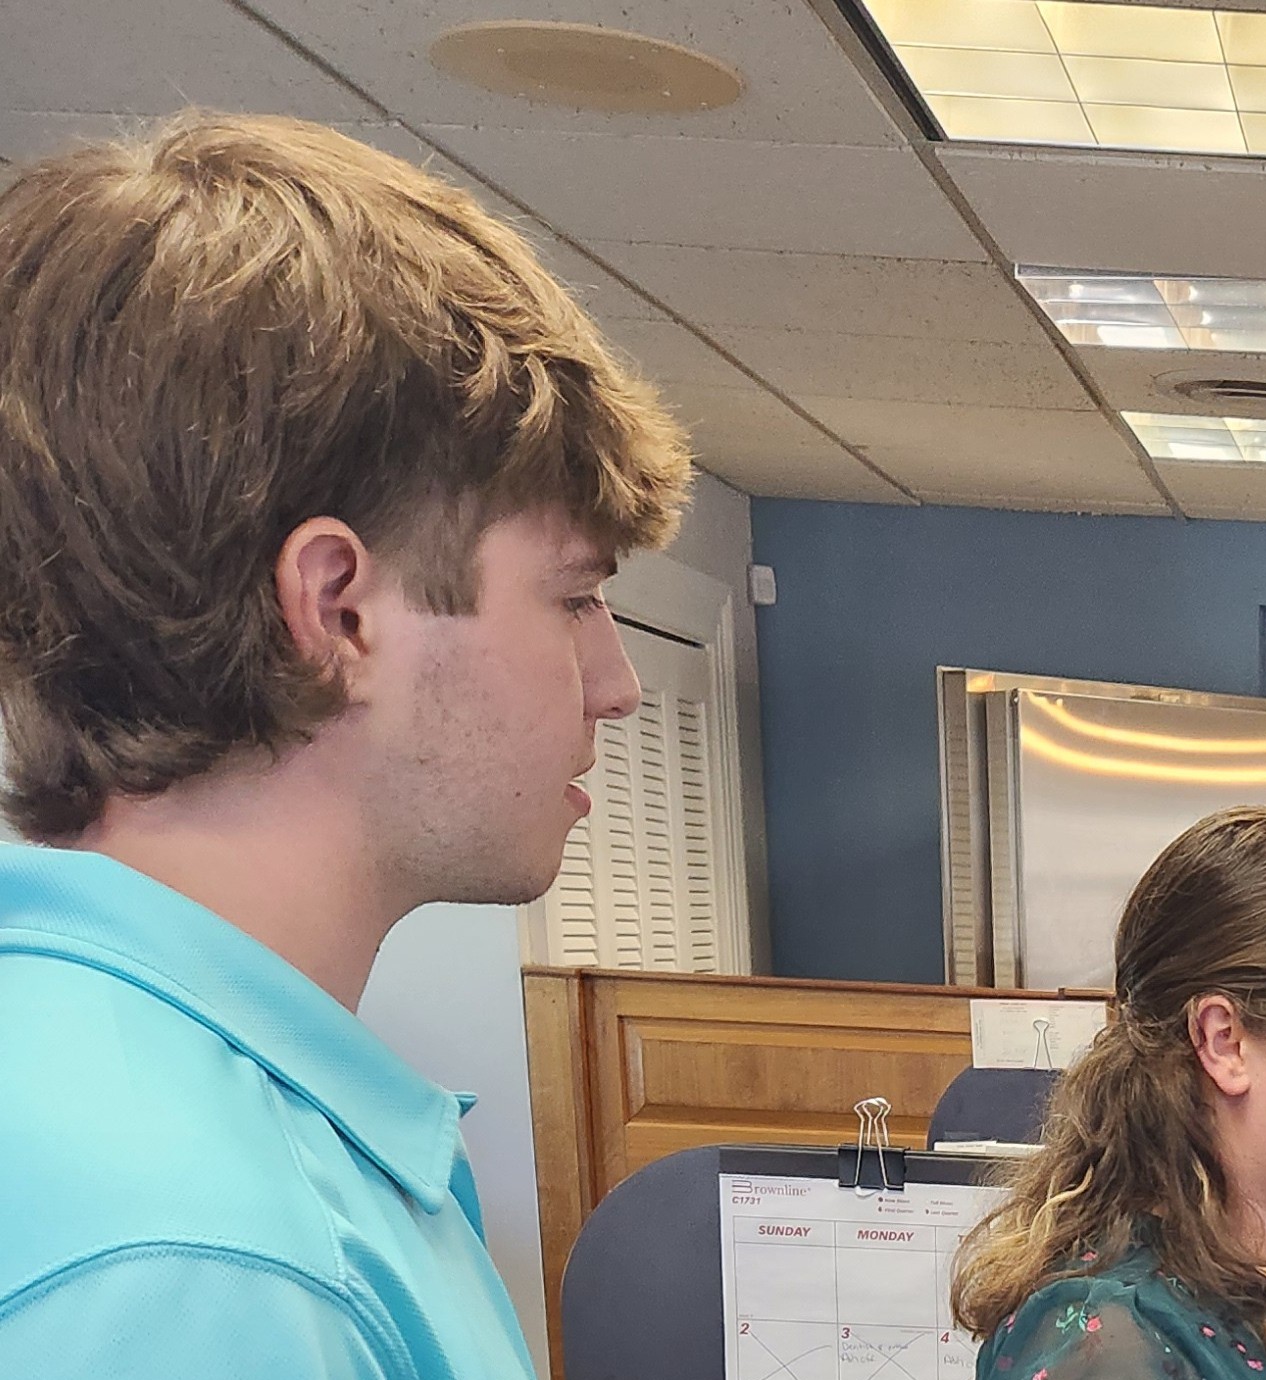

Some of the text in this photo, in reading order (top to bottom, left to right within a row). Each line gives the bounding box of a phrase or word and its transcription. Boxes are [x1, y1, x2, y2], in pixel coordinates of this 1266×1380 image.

[731, 1179, 808, 1197] Brownline
[732, 1196, 762, 1205] C1731
[758, 1225, 811, 1237] SUNDAY
[857, 1230, 914, 1242] MONDAY
[740, 1323, 750, 1335] 2
[841, 1328, 850, 1339] 3
[940, 1332, 950, 1343] 4
